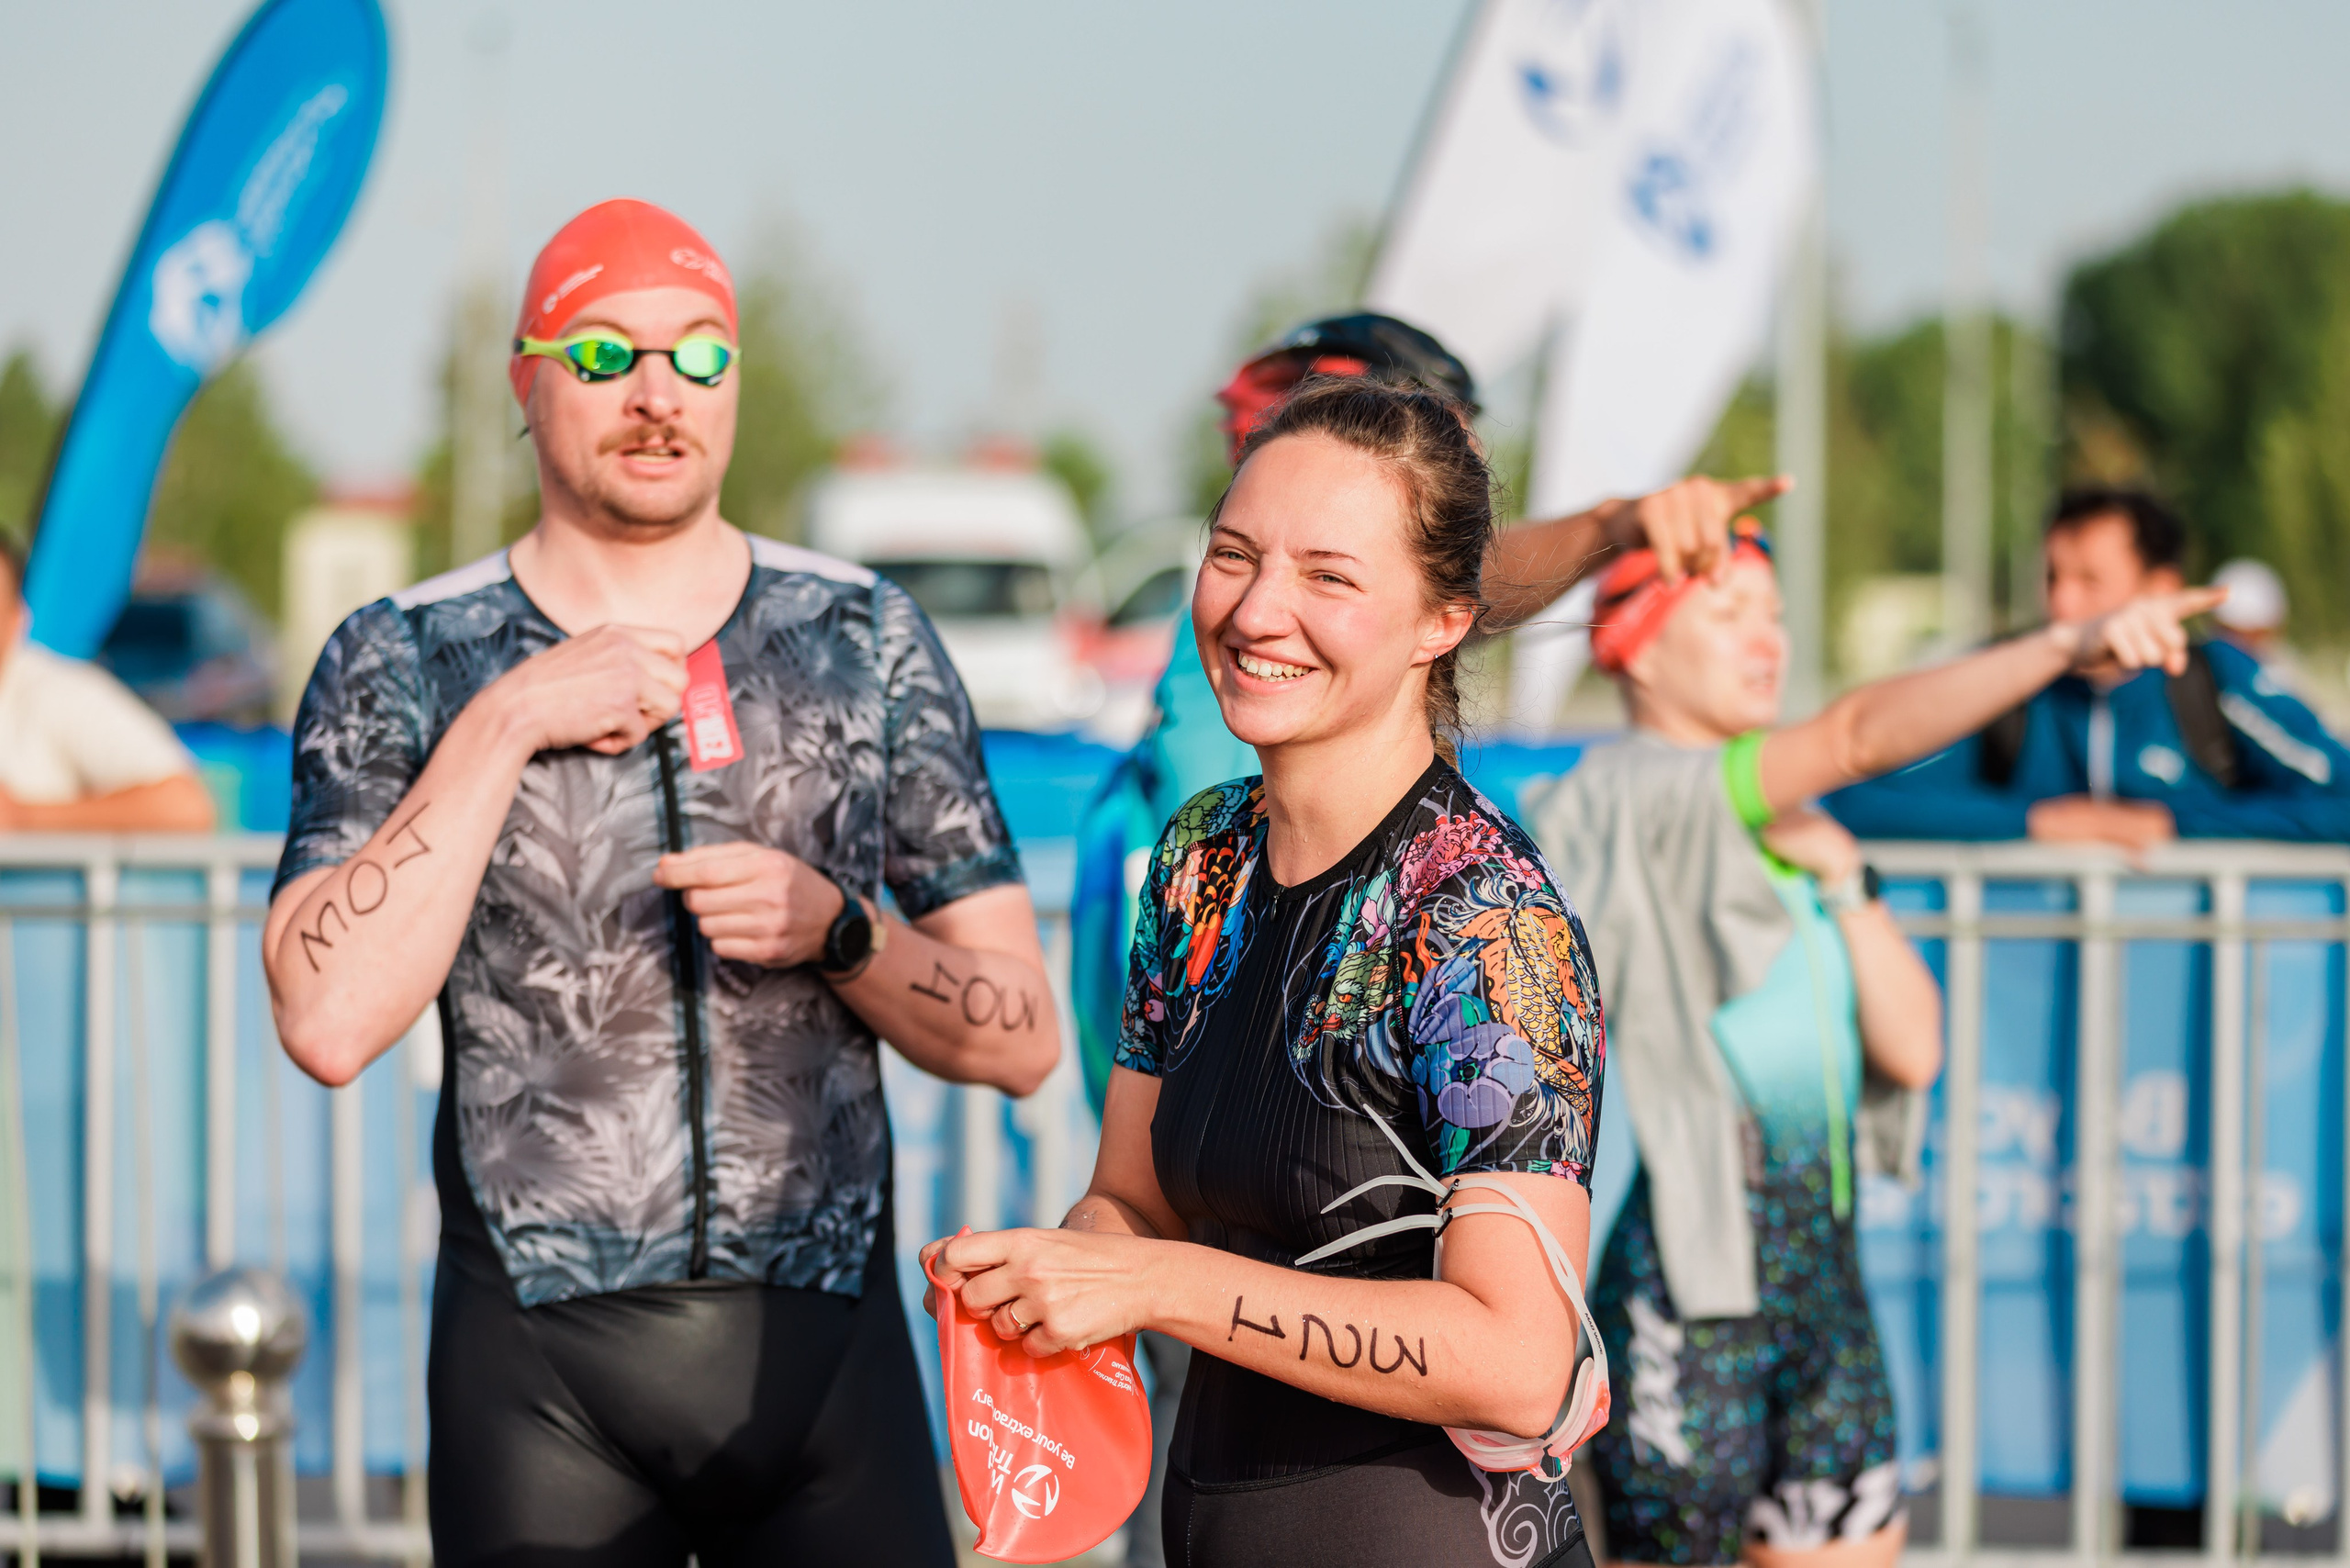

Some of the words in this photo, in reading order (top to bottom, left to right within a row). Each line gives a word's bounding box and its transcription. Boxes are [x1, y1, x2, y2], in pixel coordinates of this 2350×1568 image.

[1092, 1369, 1118, 1387] Triathlon
[1114, 1371, 1125, 1382] Cup
[1031, 1432, 1063, 1457] your
[1060, 1449, 1076, 1470] Be
